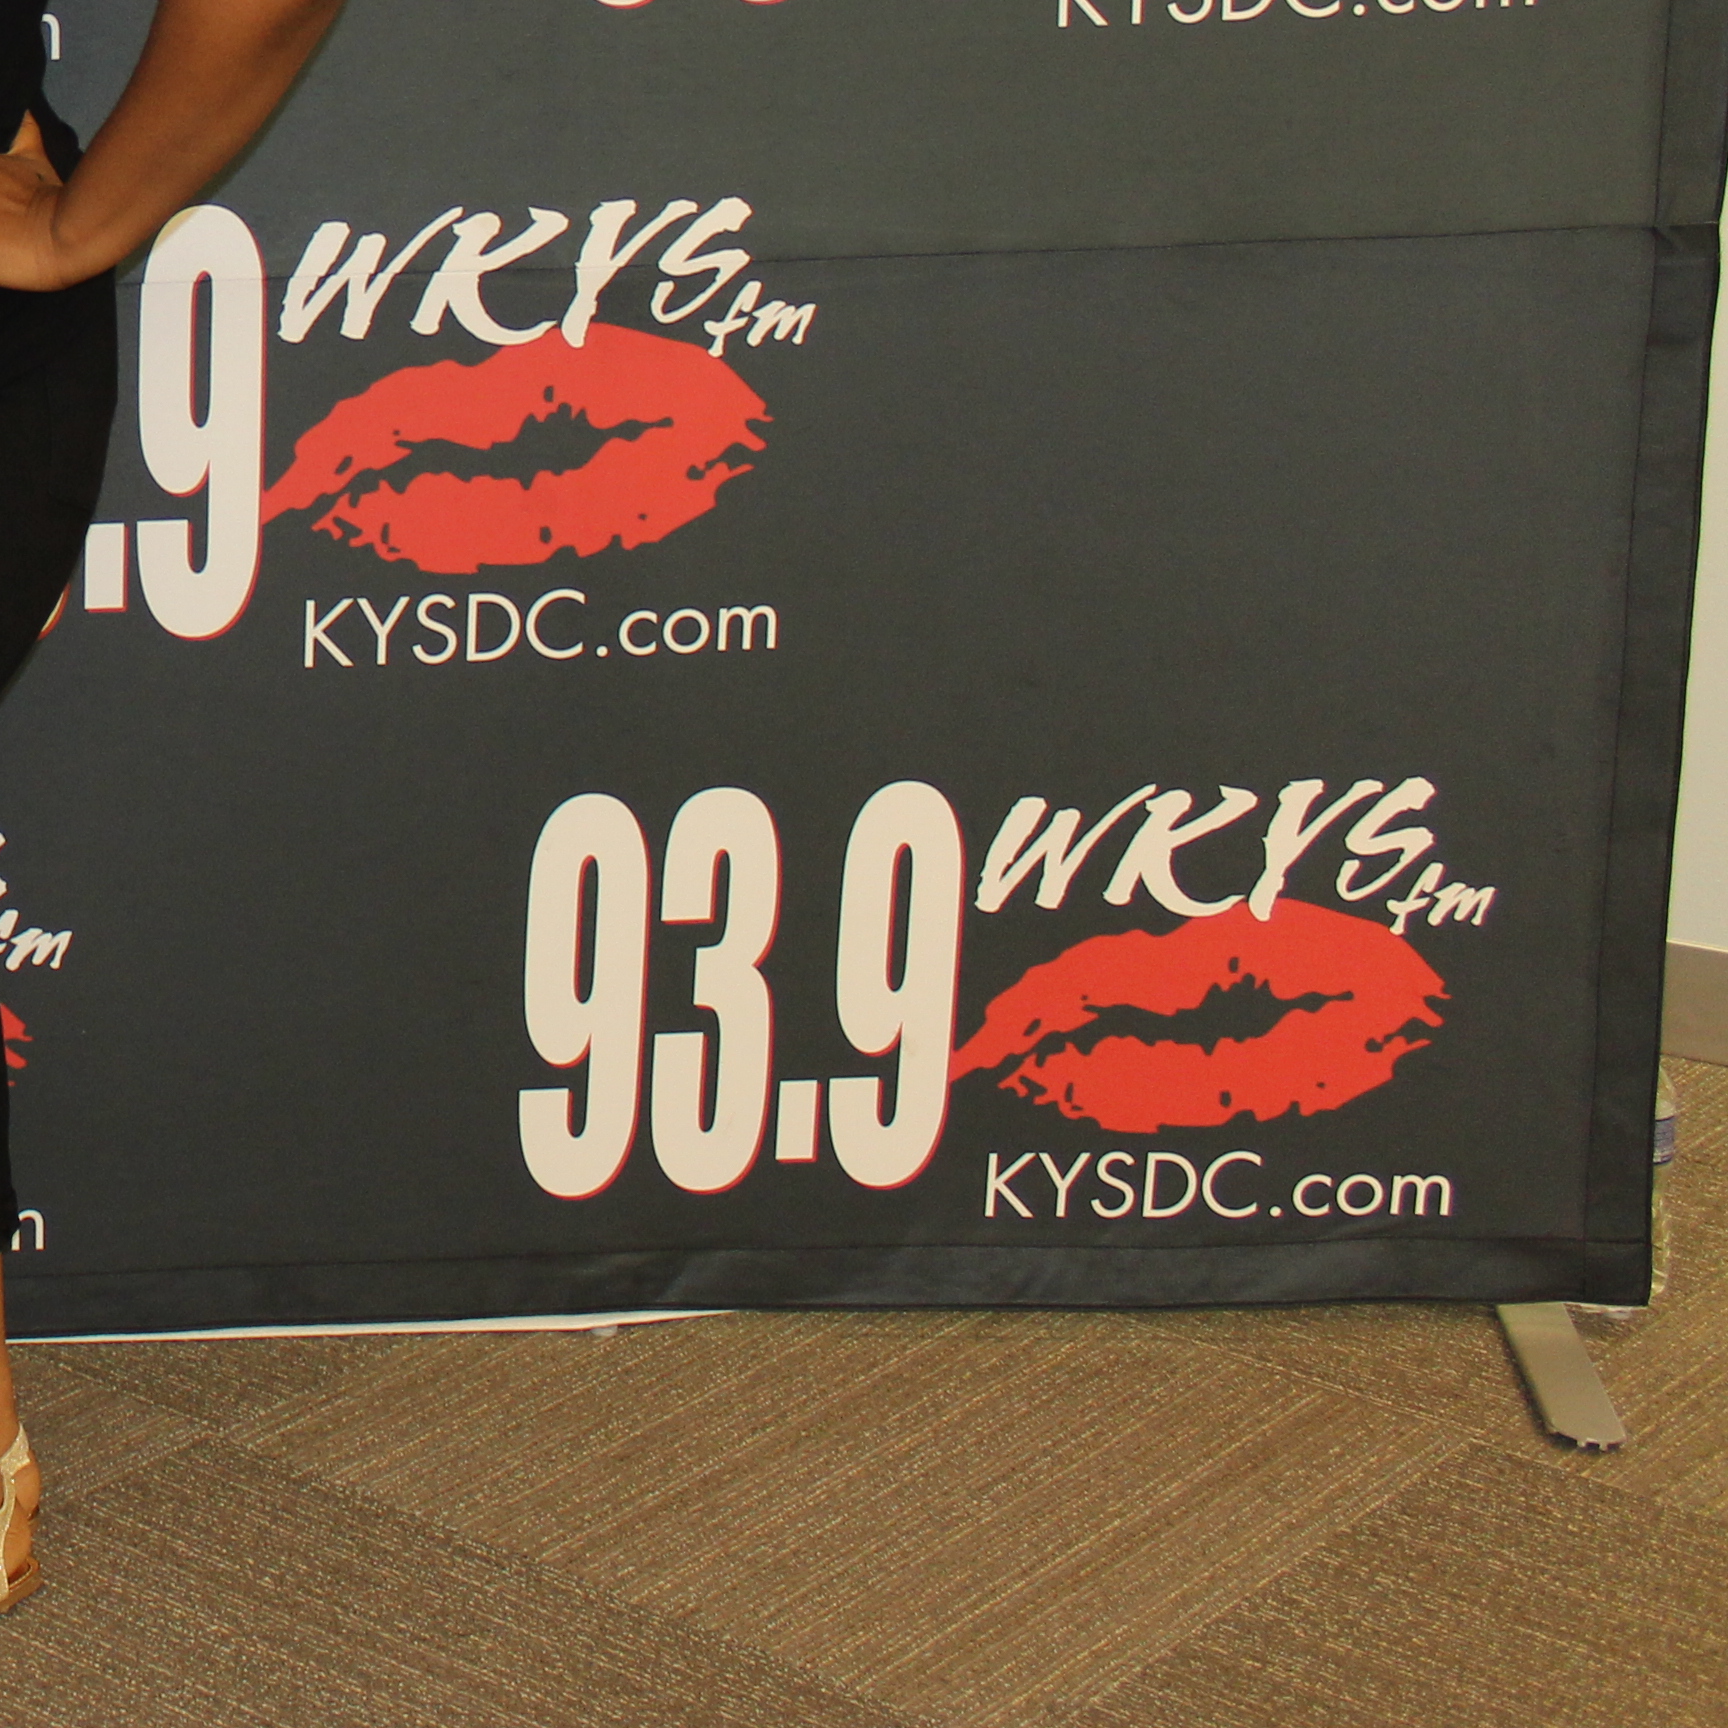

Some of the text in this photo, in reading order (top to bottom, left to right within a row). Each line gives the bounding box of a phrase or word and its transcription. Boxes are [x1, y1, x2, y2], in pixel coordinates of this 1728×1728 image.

[278, 197, 751, 347] WKYS
[704, 281, 815, 357] fm
[304, 588, 776, 668] KYSDC.com
[518, 777, 1495, 1197] 93.9 WKYS fm
[985, 1151, 1451, 1218] KYSDC.com
